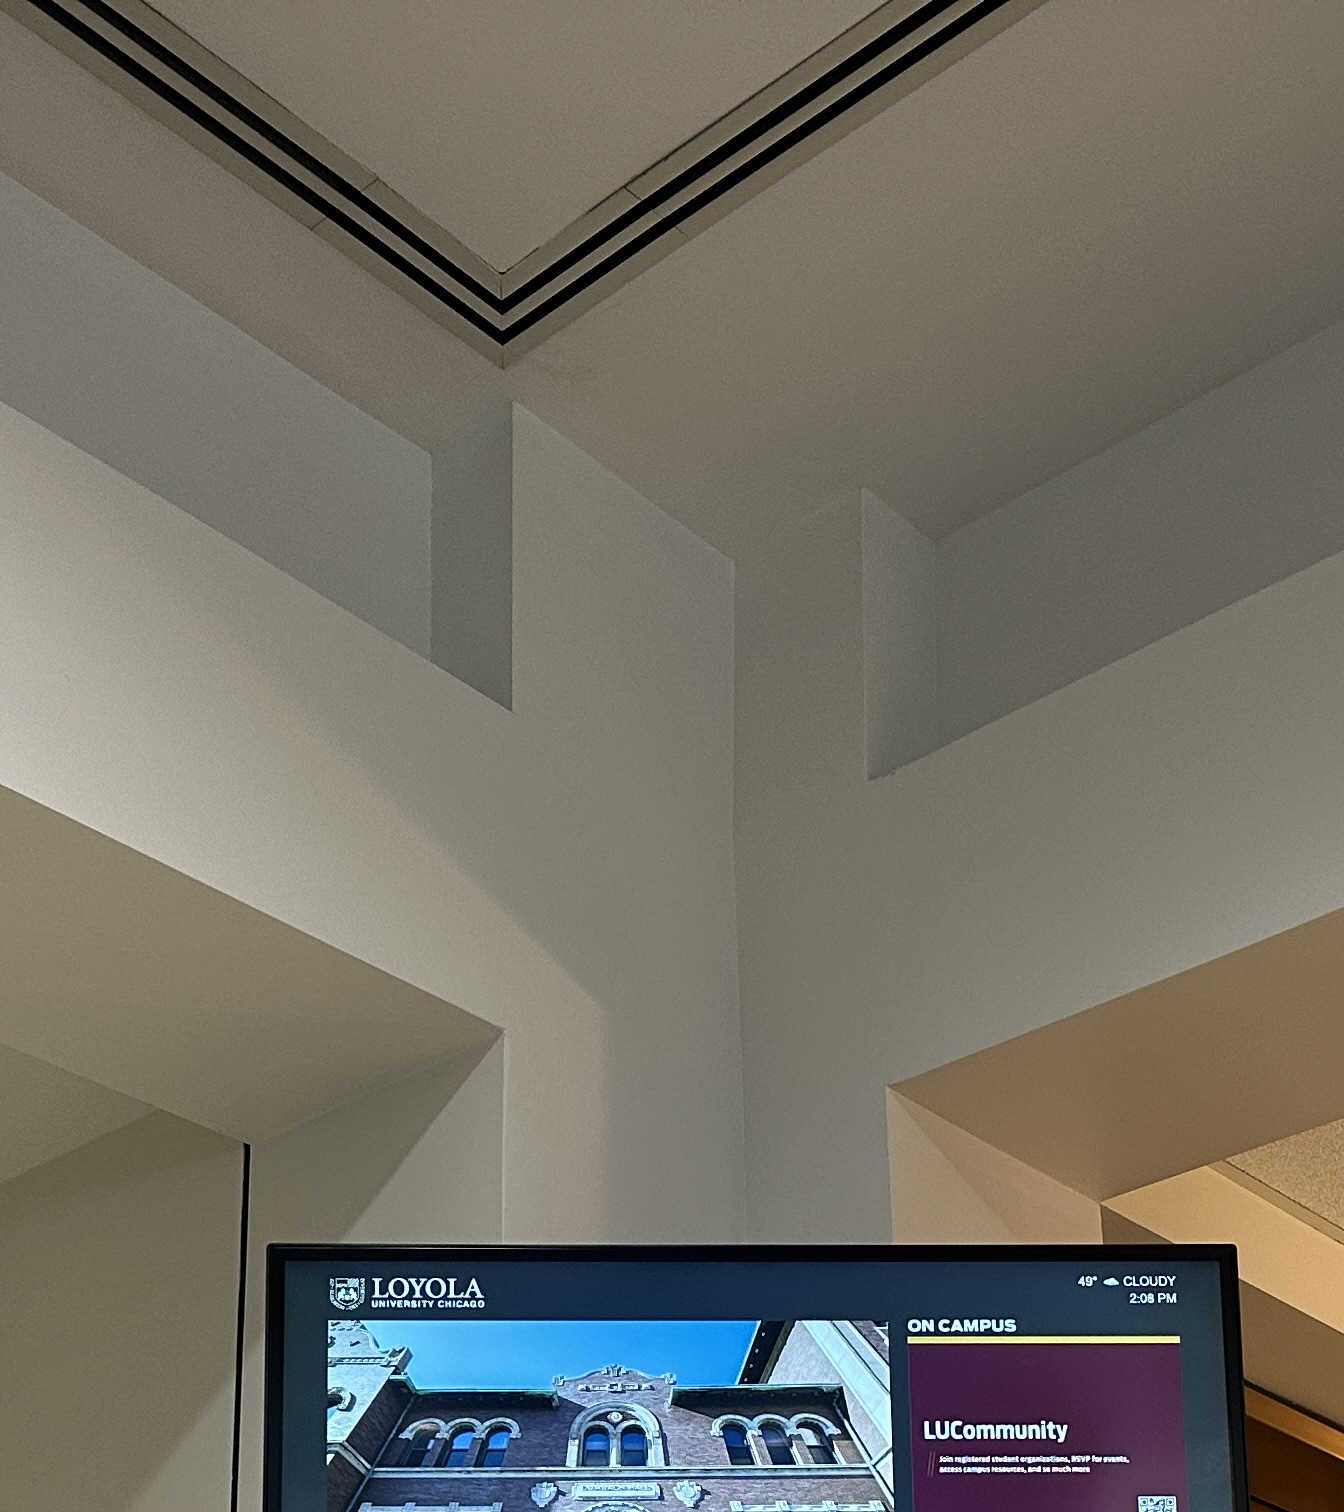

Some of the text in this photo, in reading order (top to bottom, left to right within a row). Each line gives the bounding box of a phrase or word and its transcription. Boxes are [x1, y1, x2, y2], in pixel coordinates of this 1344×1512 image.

[371, 1277, 485, 1299] LOYOLA
[1077, 1275, 1176, 1288] 49° CLOUDY
[371, 1300, 486, 1309] UNIVERSITY CHICAGO
[1129, 1292, 1177, 1304] 2:08 PM
[907, 1319, 1017, 1333] ON CAMPUS
[923, 1420, 1068, 1443] LUCommunity
